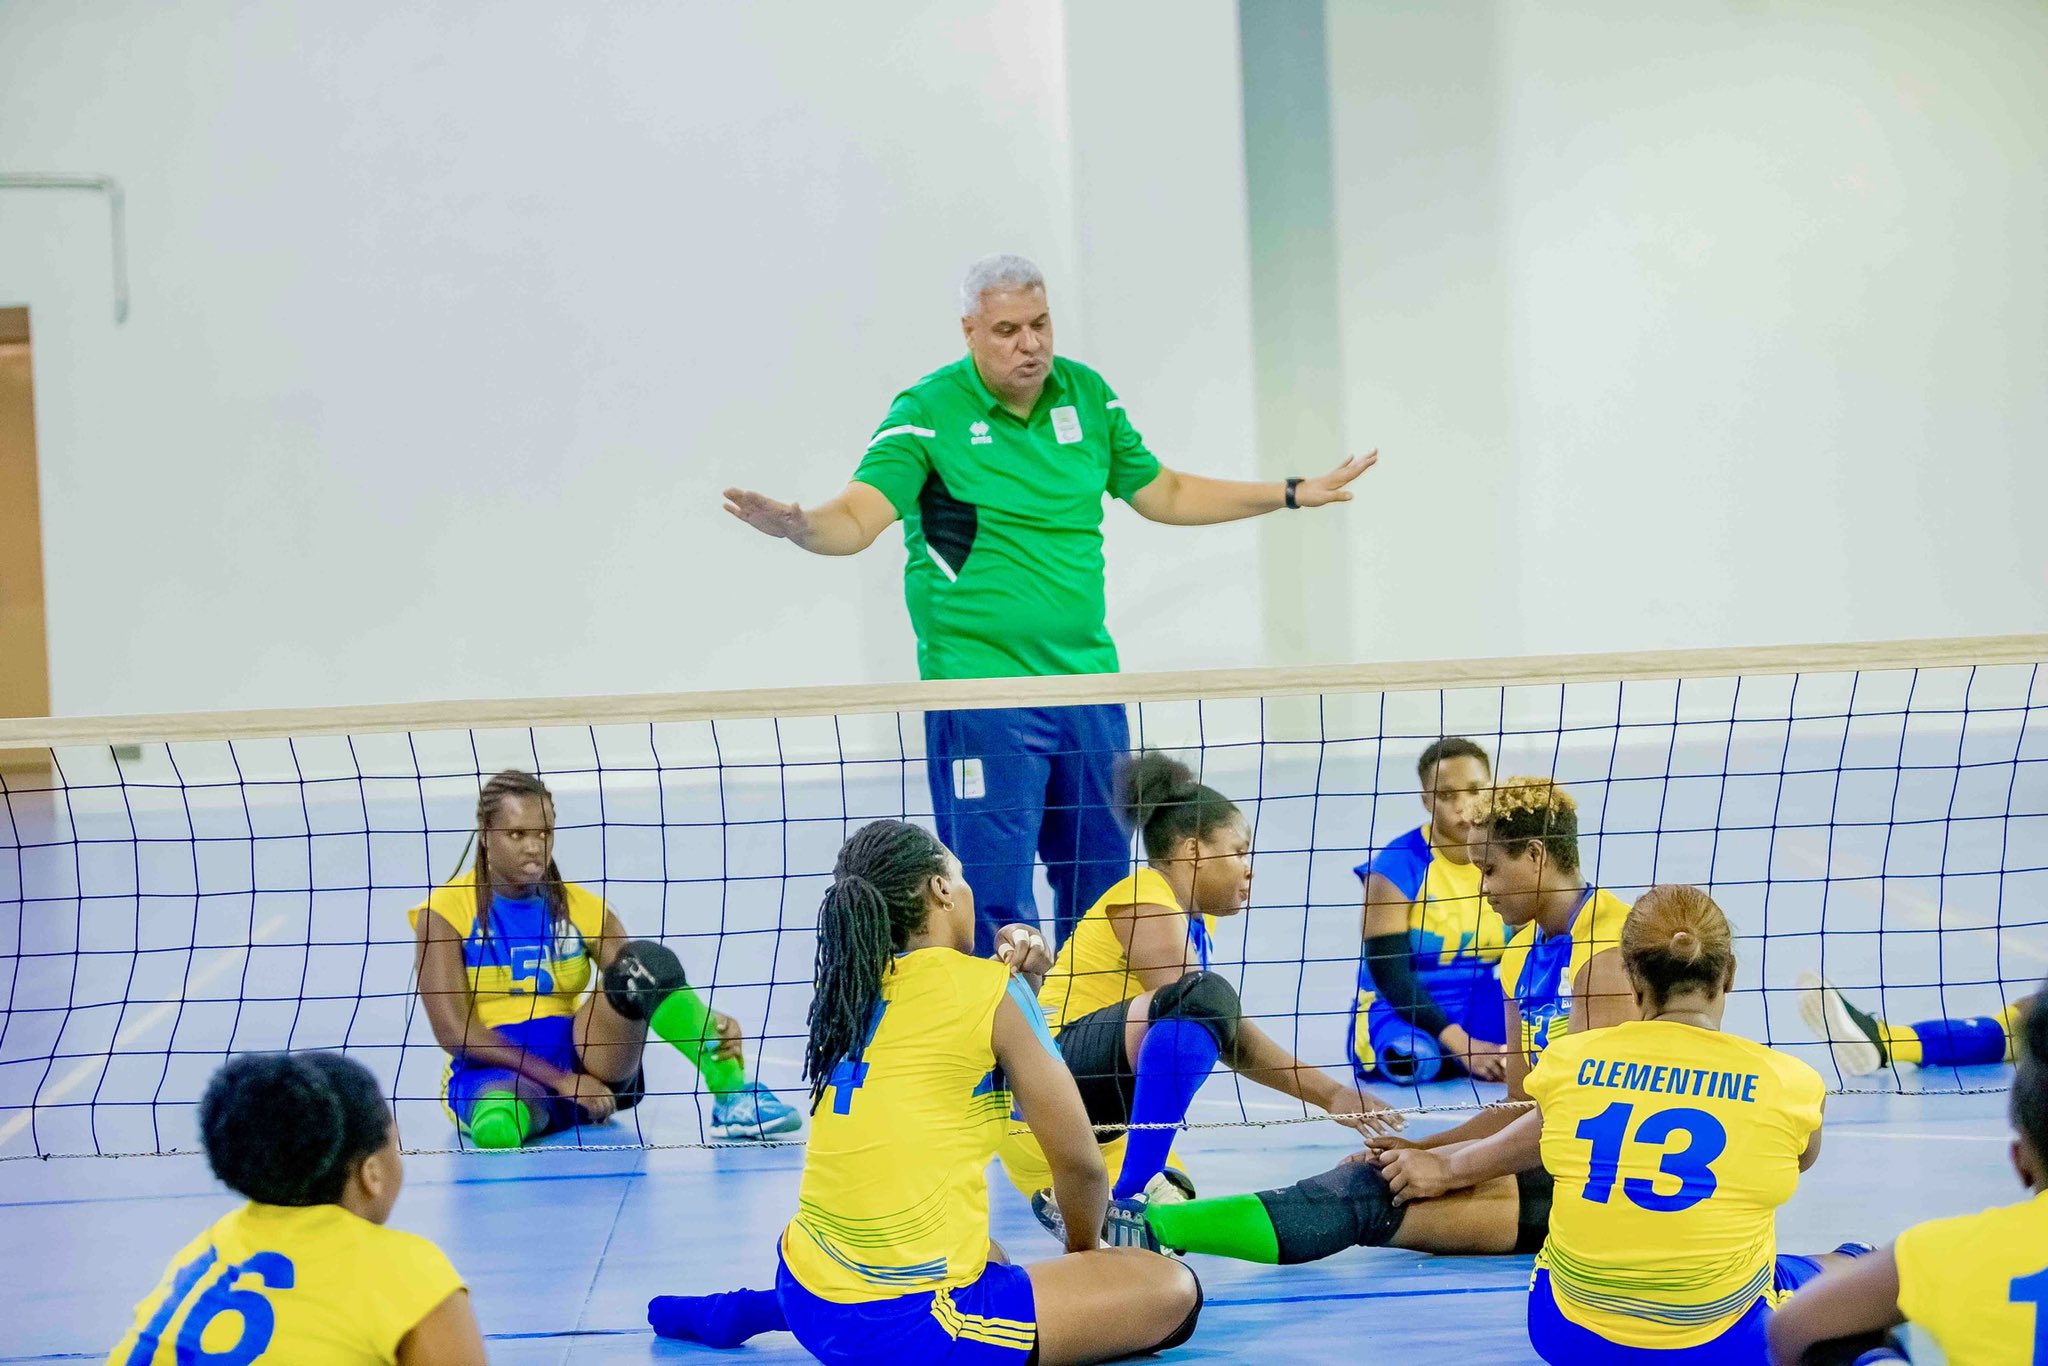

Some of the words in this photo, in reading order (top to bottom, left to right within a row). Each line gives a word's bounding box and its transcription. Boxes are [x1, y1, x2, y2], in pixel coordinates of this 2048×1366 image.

[510, 944, 555, 995] 5
[1577, 1058, 1759, 1103] CLEMENTINE
[1575, 1101, 1727, 1213] 13
[124, 1244, 295, 1366] 16
